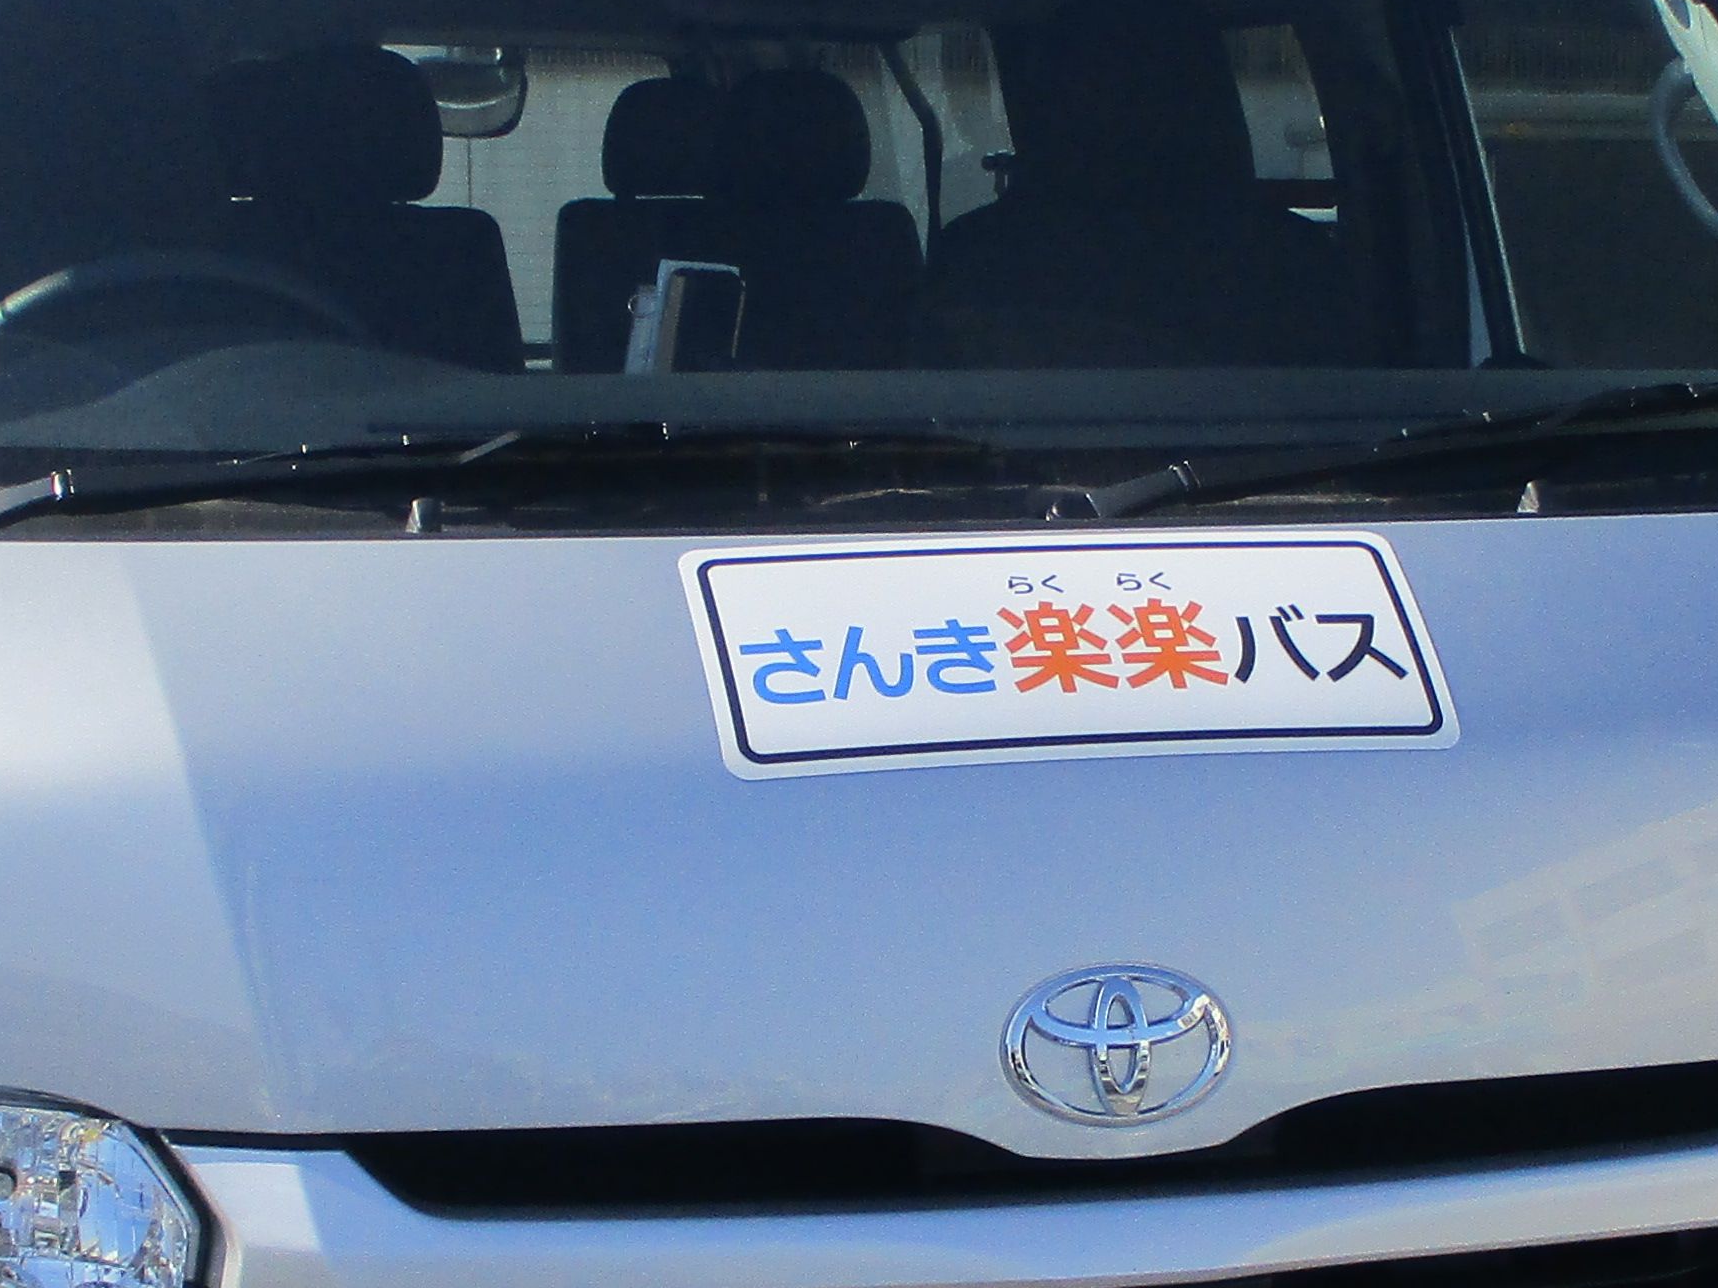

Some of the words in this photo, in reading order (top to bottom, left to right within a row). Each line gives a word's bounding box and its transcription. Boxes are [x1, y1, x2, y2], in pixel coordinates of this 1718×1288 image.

[1007, 574, 1065, 594] らく
[1116, 571, 1172, 592] らく
[739, 598, 1409, 705] さんき楽楽バス
